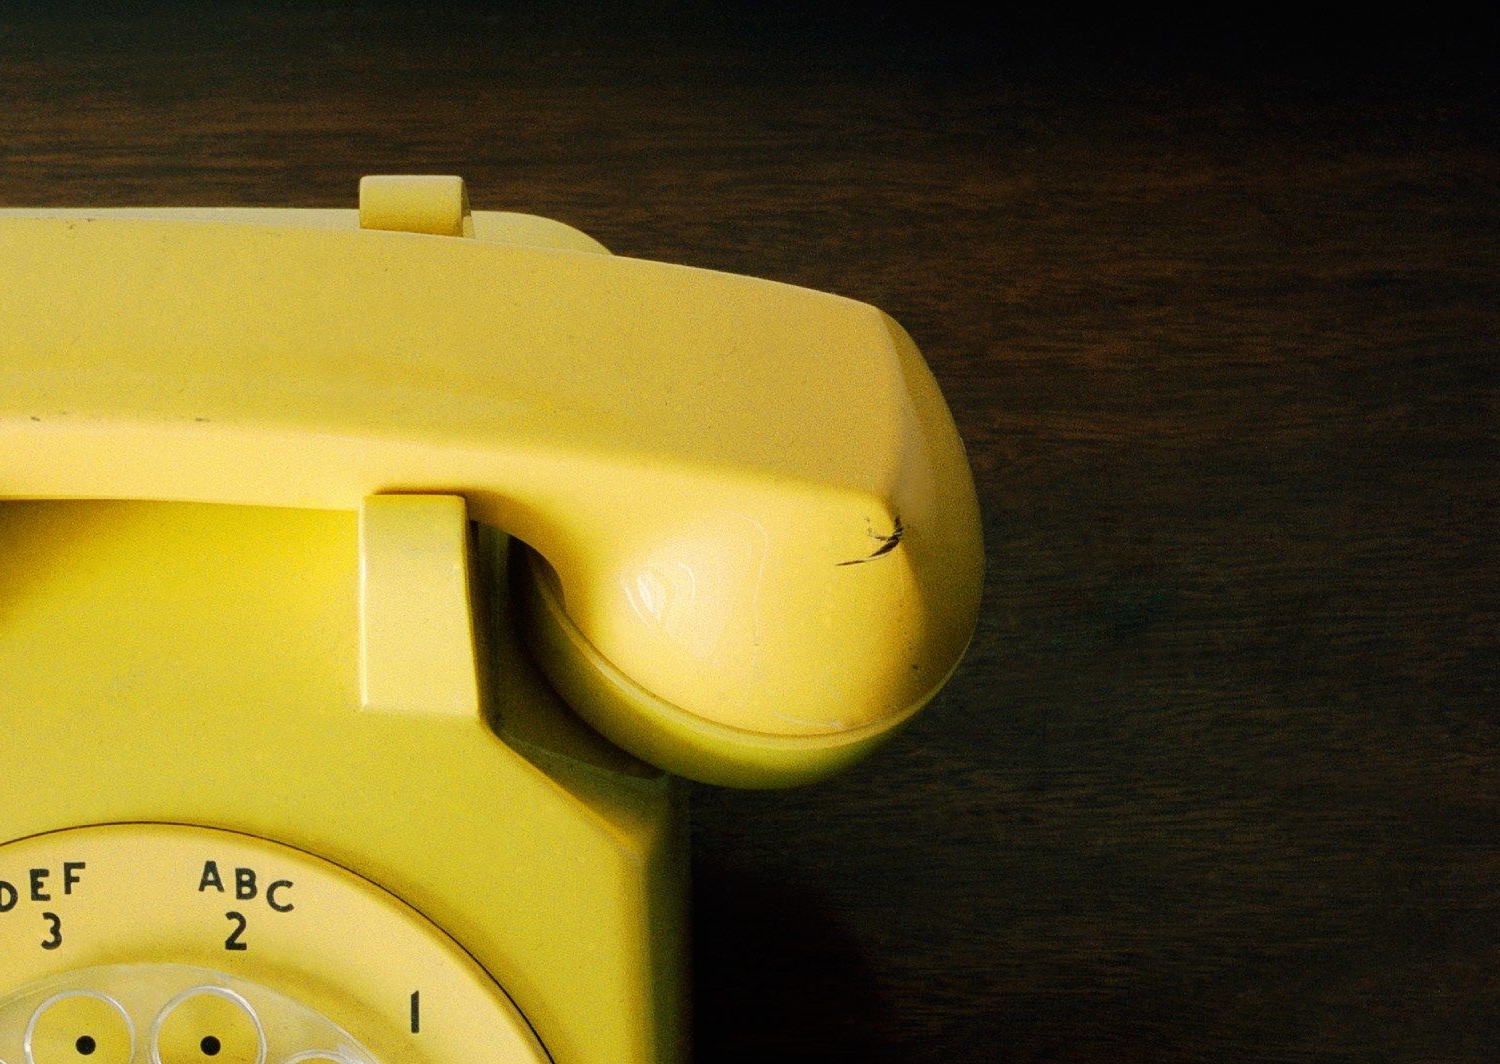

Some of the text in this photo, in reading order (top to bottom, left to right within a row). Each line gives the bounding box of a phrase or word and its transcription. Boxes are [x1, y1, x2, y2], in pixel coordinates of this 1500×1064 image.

[199, 861, 293, 912] ABC
[41, 912, 62, 949] 3
[225, 912, 247, 950] 2
[410, 990, 421, 1034] 1
